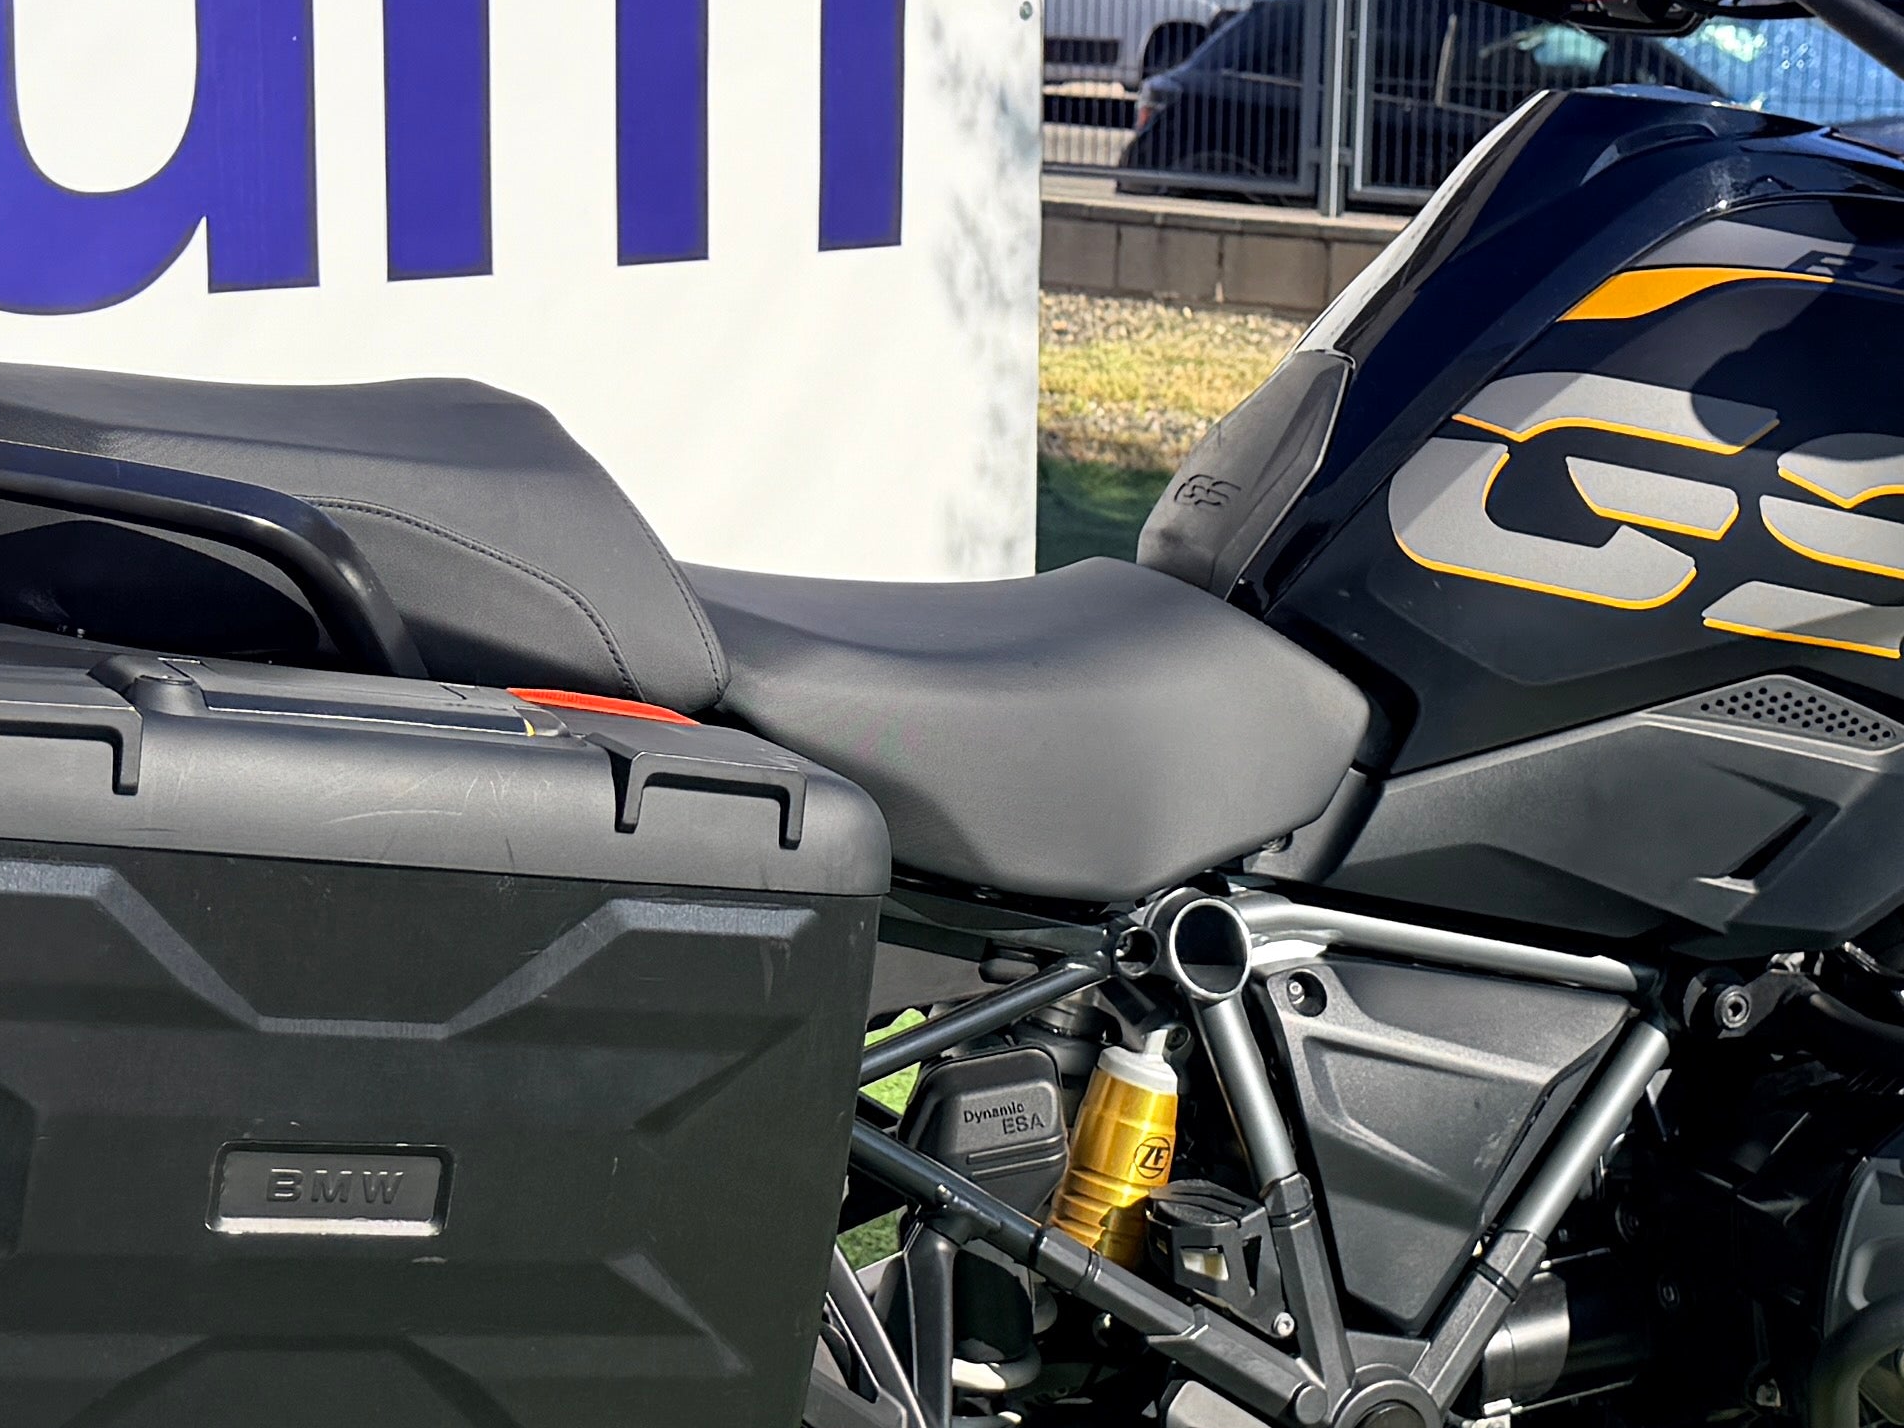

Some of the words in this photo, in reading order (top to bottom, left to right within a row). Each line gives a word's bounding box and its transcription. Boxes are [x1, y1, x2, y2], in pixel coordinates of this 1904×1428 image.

[963, 1101, 1025, 1124] Dynamic
[1002, 1113, 1045, 1135] ESA
[1138, 1143, 1171, 1173] ZF
[266, 1168, 404, 1204] BMW
